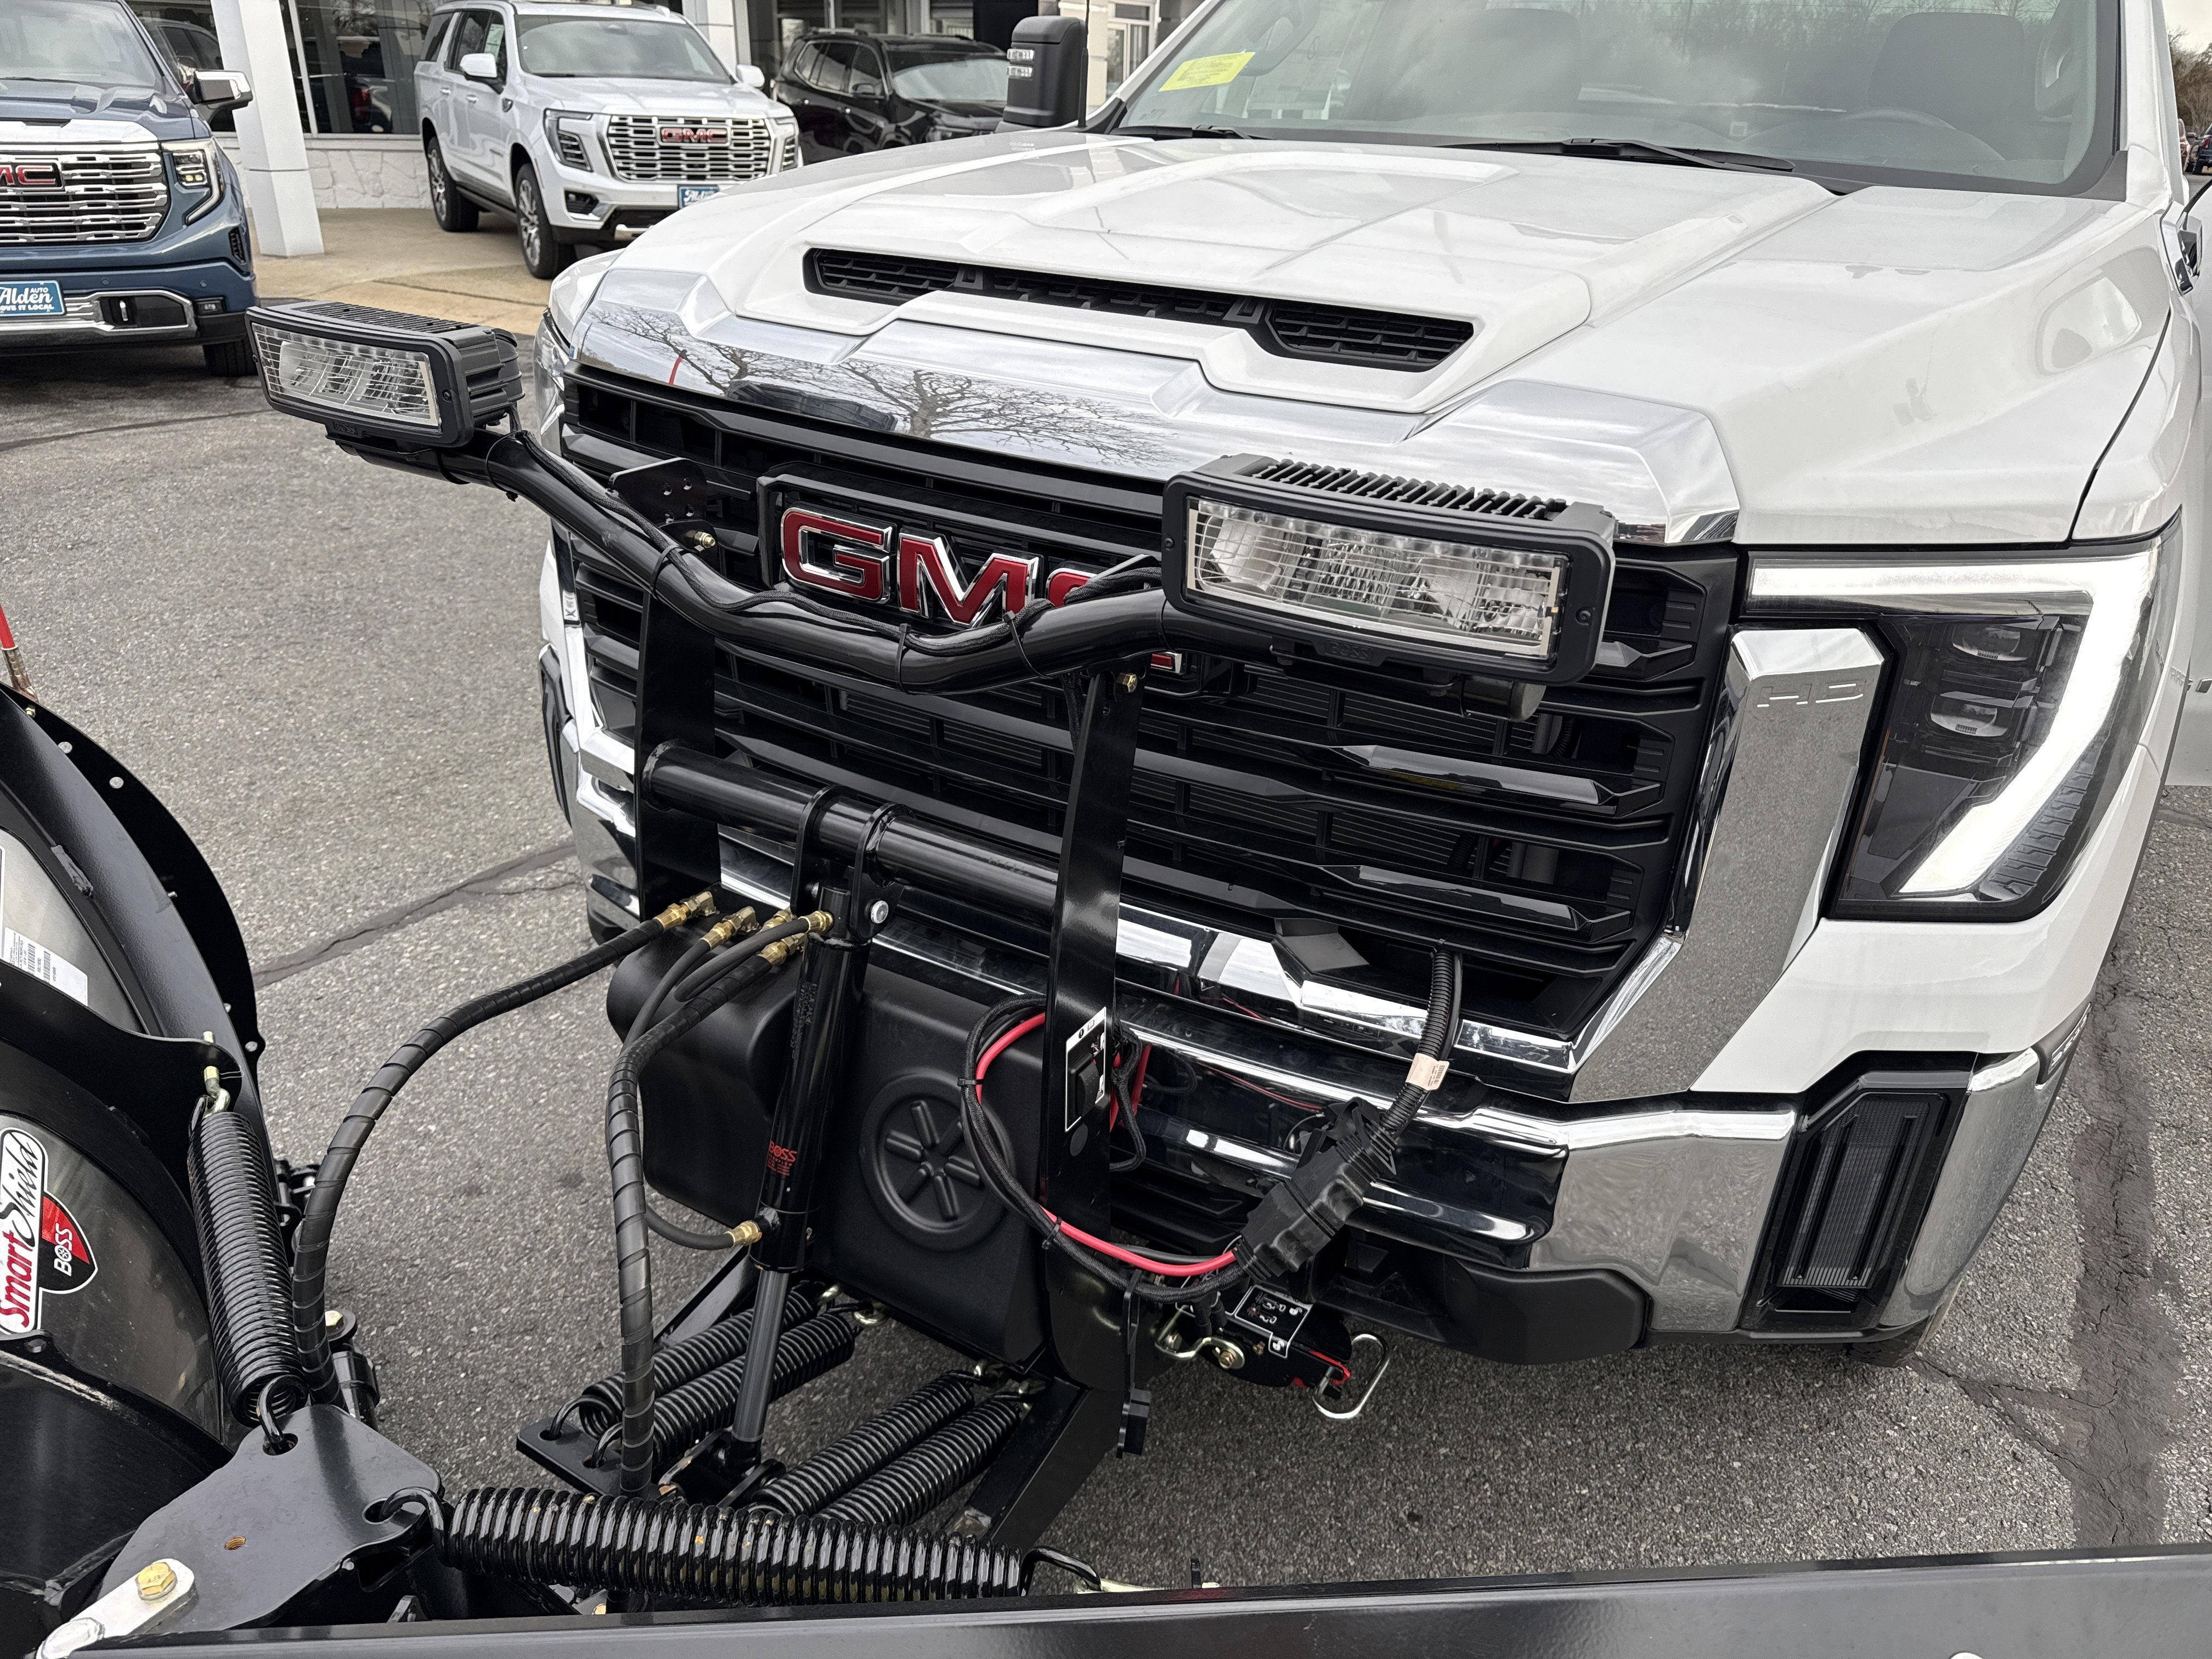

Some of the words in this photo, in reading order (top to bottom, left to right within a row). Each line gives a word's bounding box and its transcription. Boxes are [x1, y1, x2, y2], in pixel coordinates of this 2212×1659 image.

[661, 128, 727, 143] GMC
[0, 287, 53, 304] Alden
[1757, 679, 1866, 708] HD
[769, 1141, 797, 1163] BOSS
[54, 1223, 72, 1276] BOSS
